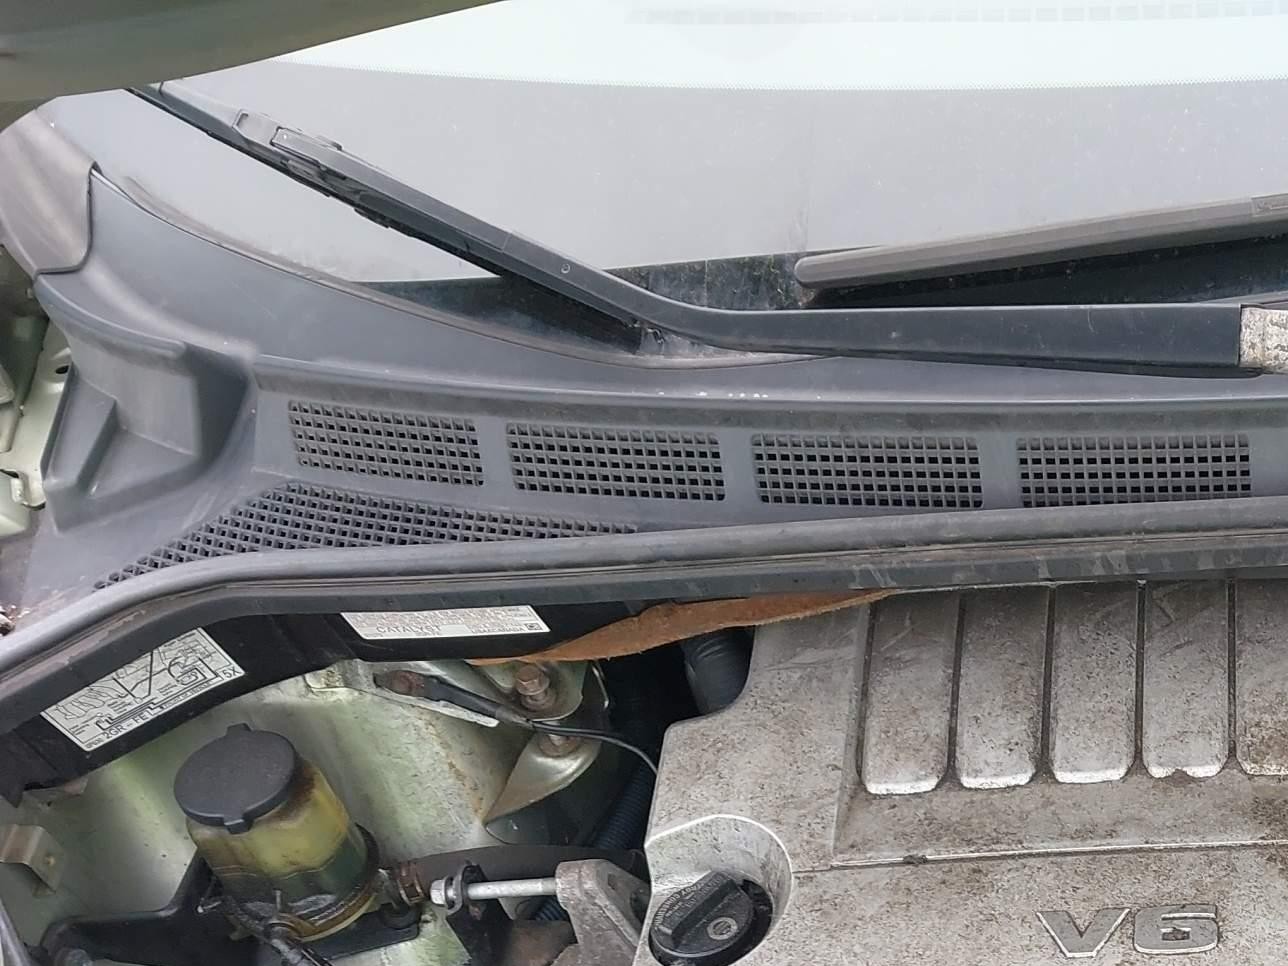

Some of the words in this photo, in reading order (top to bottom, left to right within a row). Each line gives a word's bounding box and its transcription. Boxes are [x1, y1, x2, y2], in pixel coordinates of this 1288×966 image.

[376, 624, 441, 634] CATALYST
[222, 668, 241, 680] 5X
[1035, 904, 1220, 958] V6
